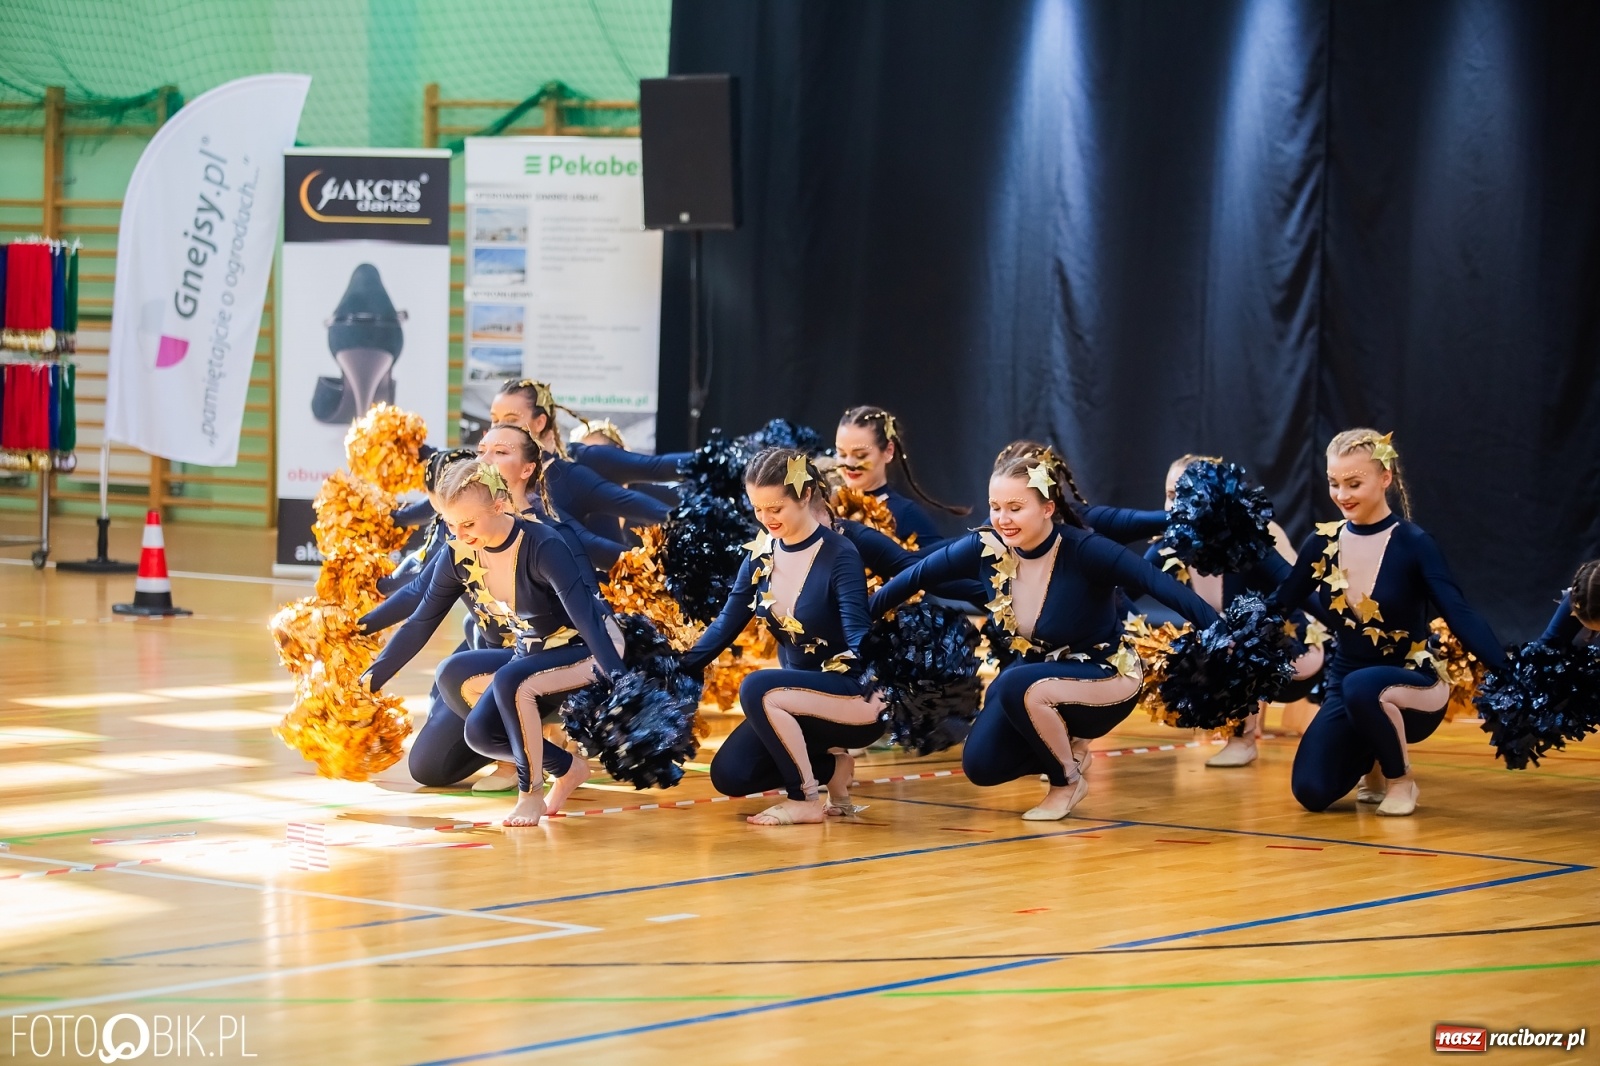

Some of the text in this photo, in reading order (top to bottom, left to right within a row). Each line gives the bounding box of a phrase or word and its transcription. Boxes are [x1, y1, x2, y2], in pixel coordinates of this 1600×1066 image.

[548, 154, 640, 177] Pekabe
[338, 178, 422, 202] AKCES
[356, 200, 422, 213] dance
[220, 291, 235, 307] o
